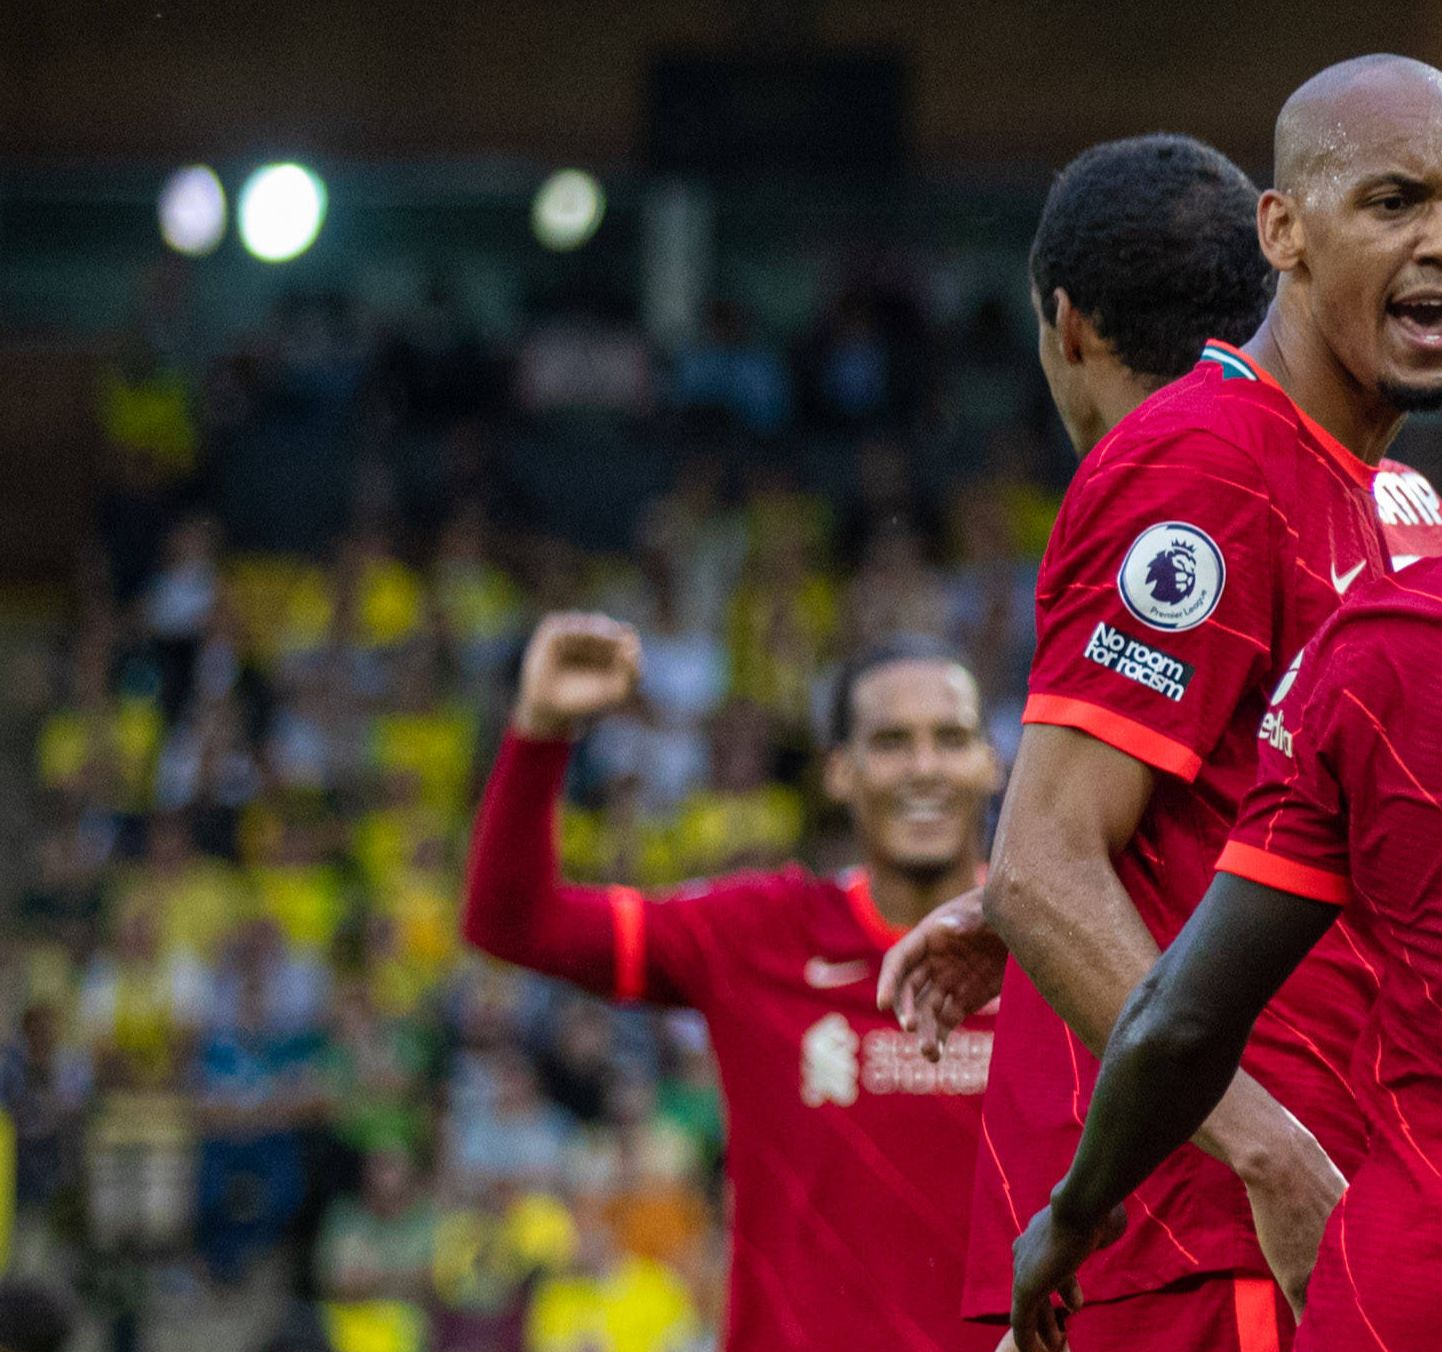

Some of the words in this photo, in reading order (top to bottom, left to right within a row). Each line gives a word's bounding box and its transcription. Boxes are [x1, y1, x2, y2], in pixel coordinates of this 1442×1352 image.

[1150, 605, 1183, 619] Premier
[1083, 641, 1118, 668] for
[1115, 655, 1185, 702] racism
[1092, 621, 1126, 650] No
[1125, 641, 1184, 681] room
